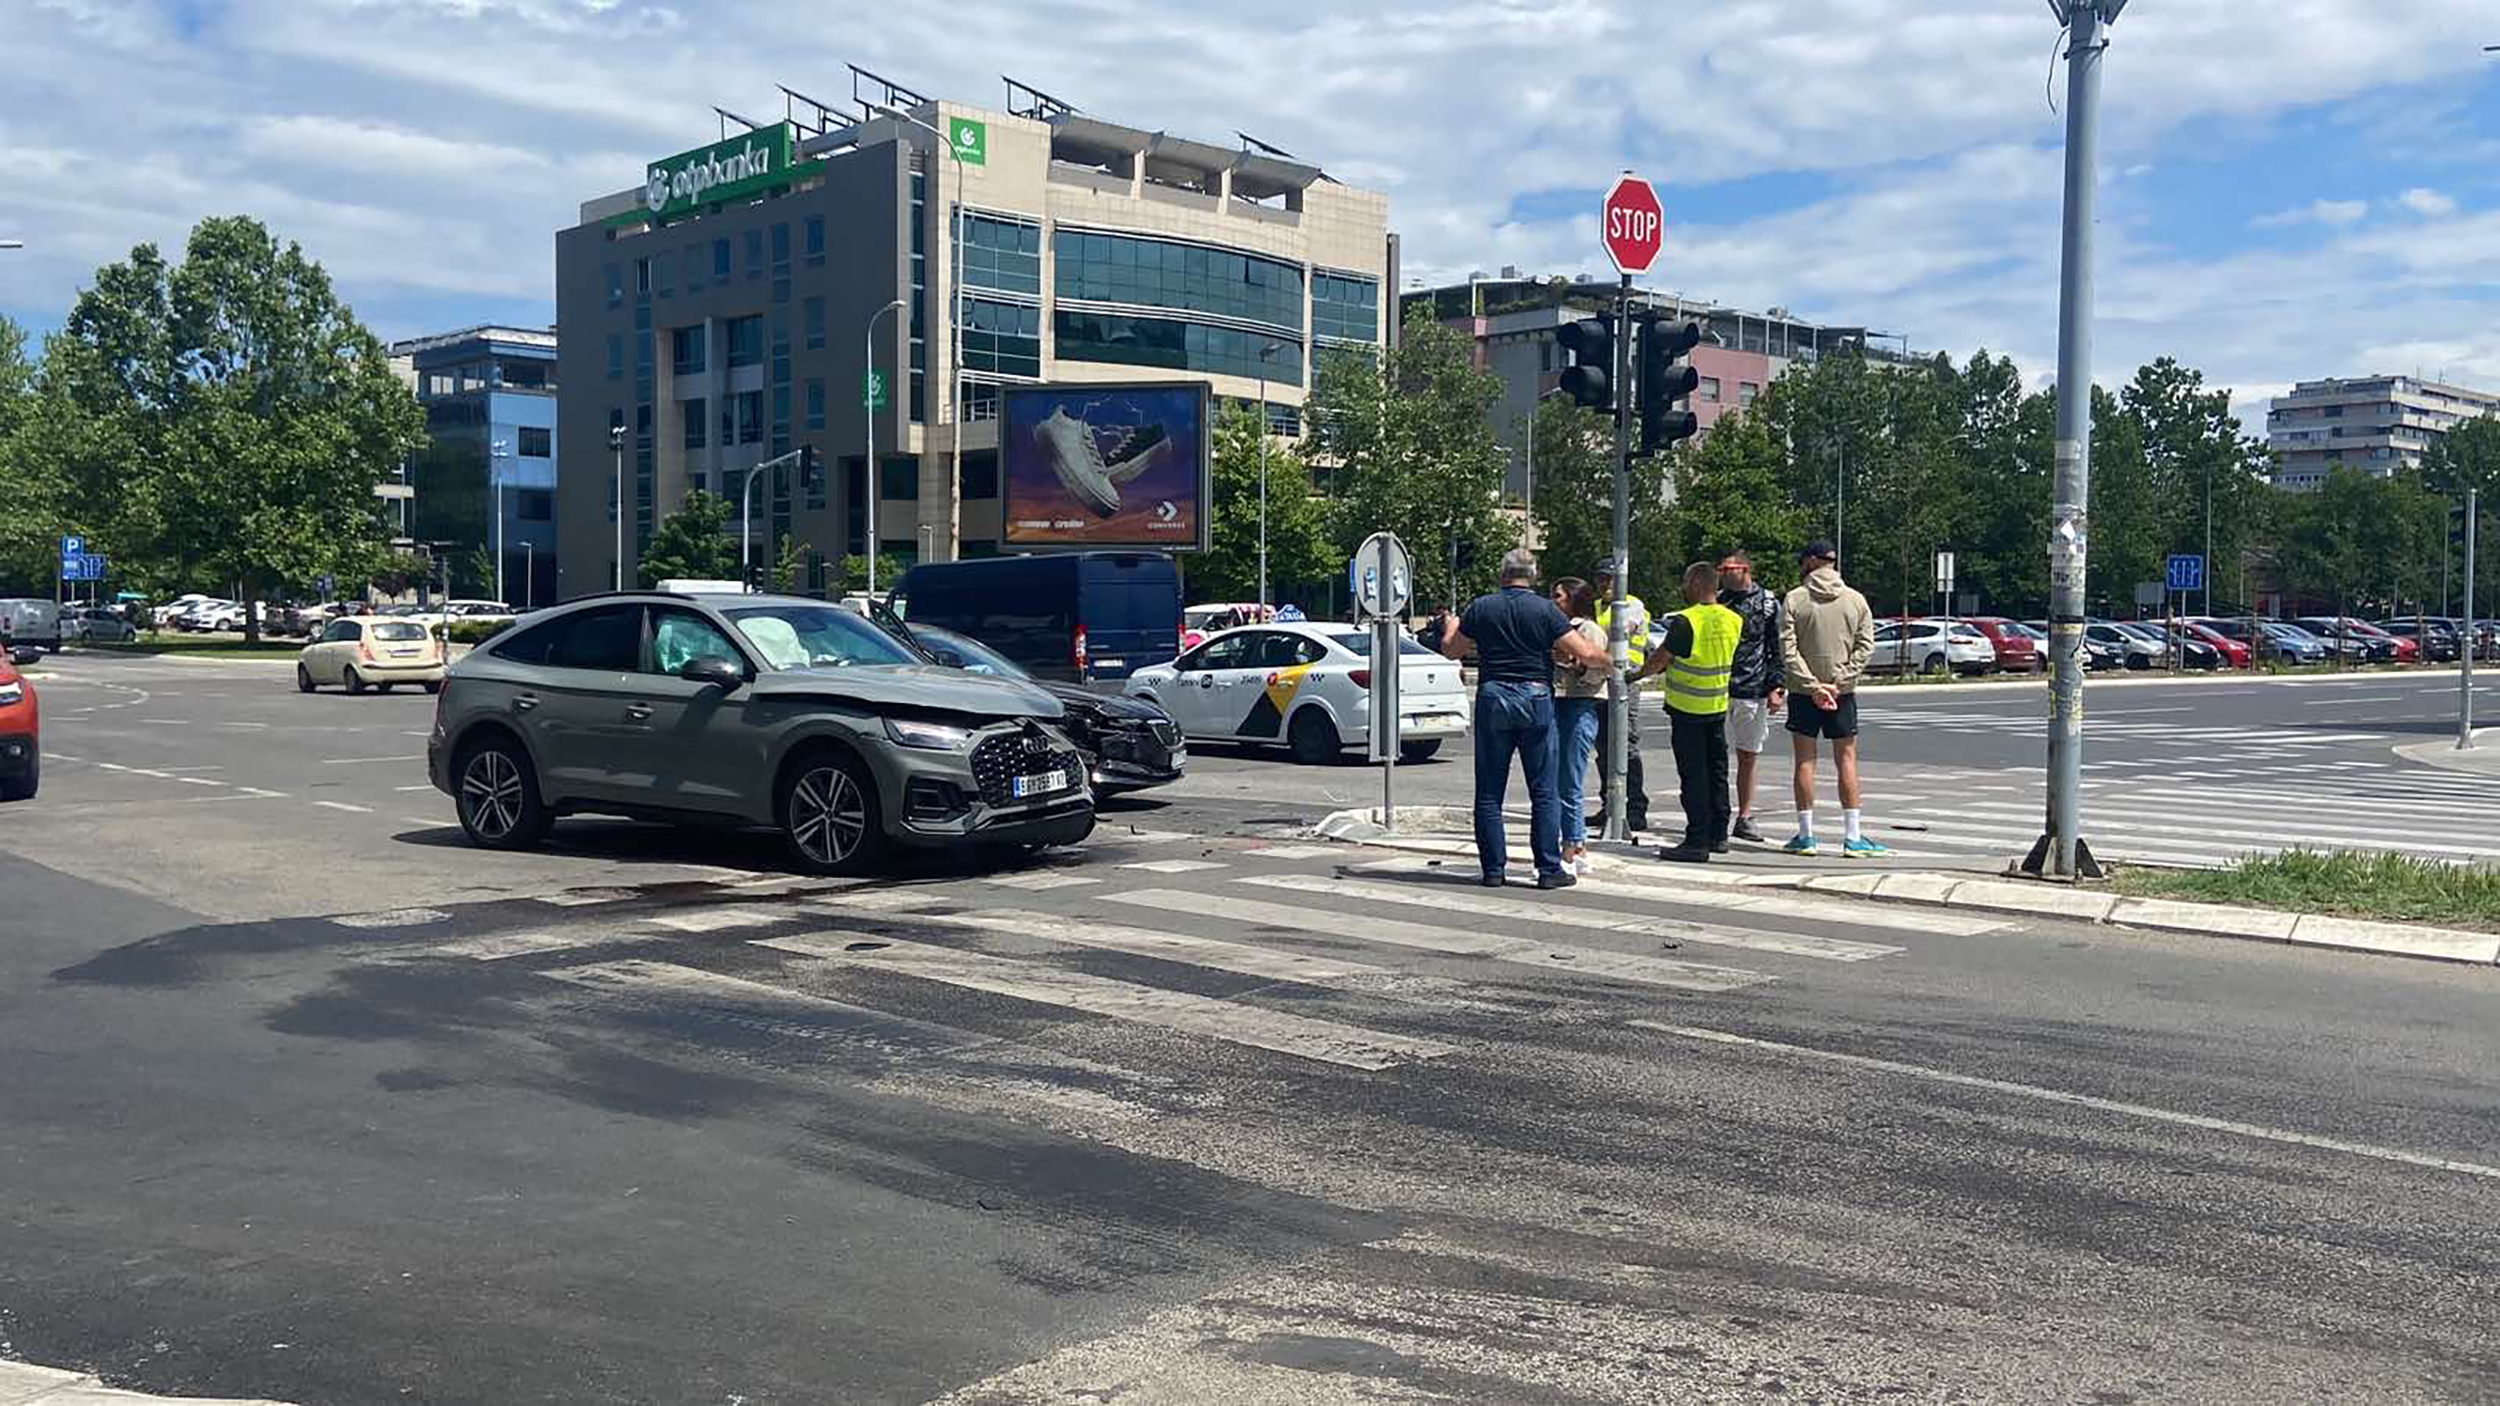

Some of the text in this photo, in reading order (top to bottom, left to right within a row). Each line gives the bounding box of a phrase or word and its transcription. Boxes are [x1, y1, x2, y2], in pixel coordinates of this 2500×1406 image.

[672, 140, 769, 205] otpbanka
[1611, 207, 1657, 242] STOP
[67, 539, 79, 552] P
